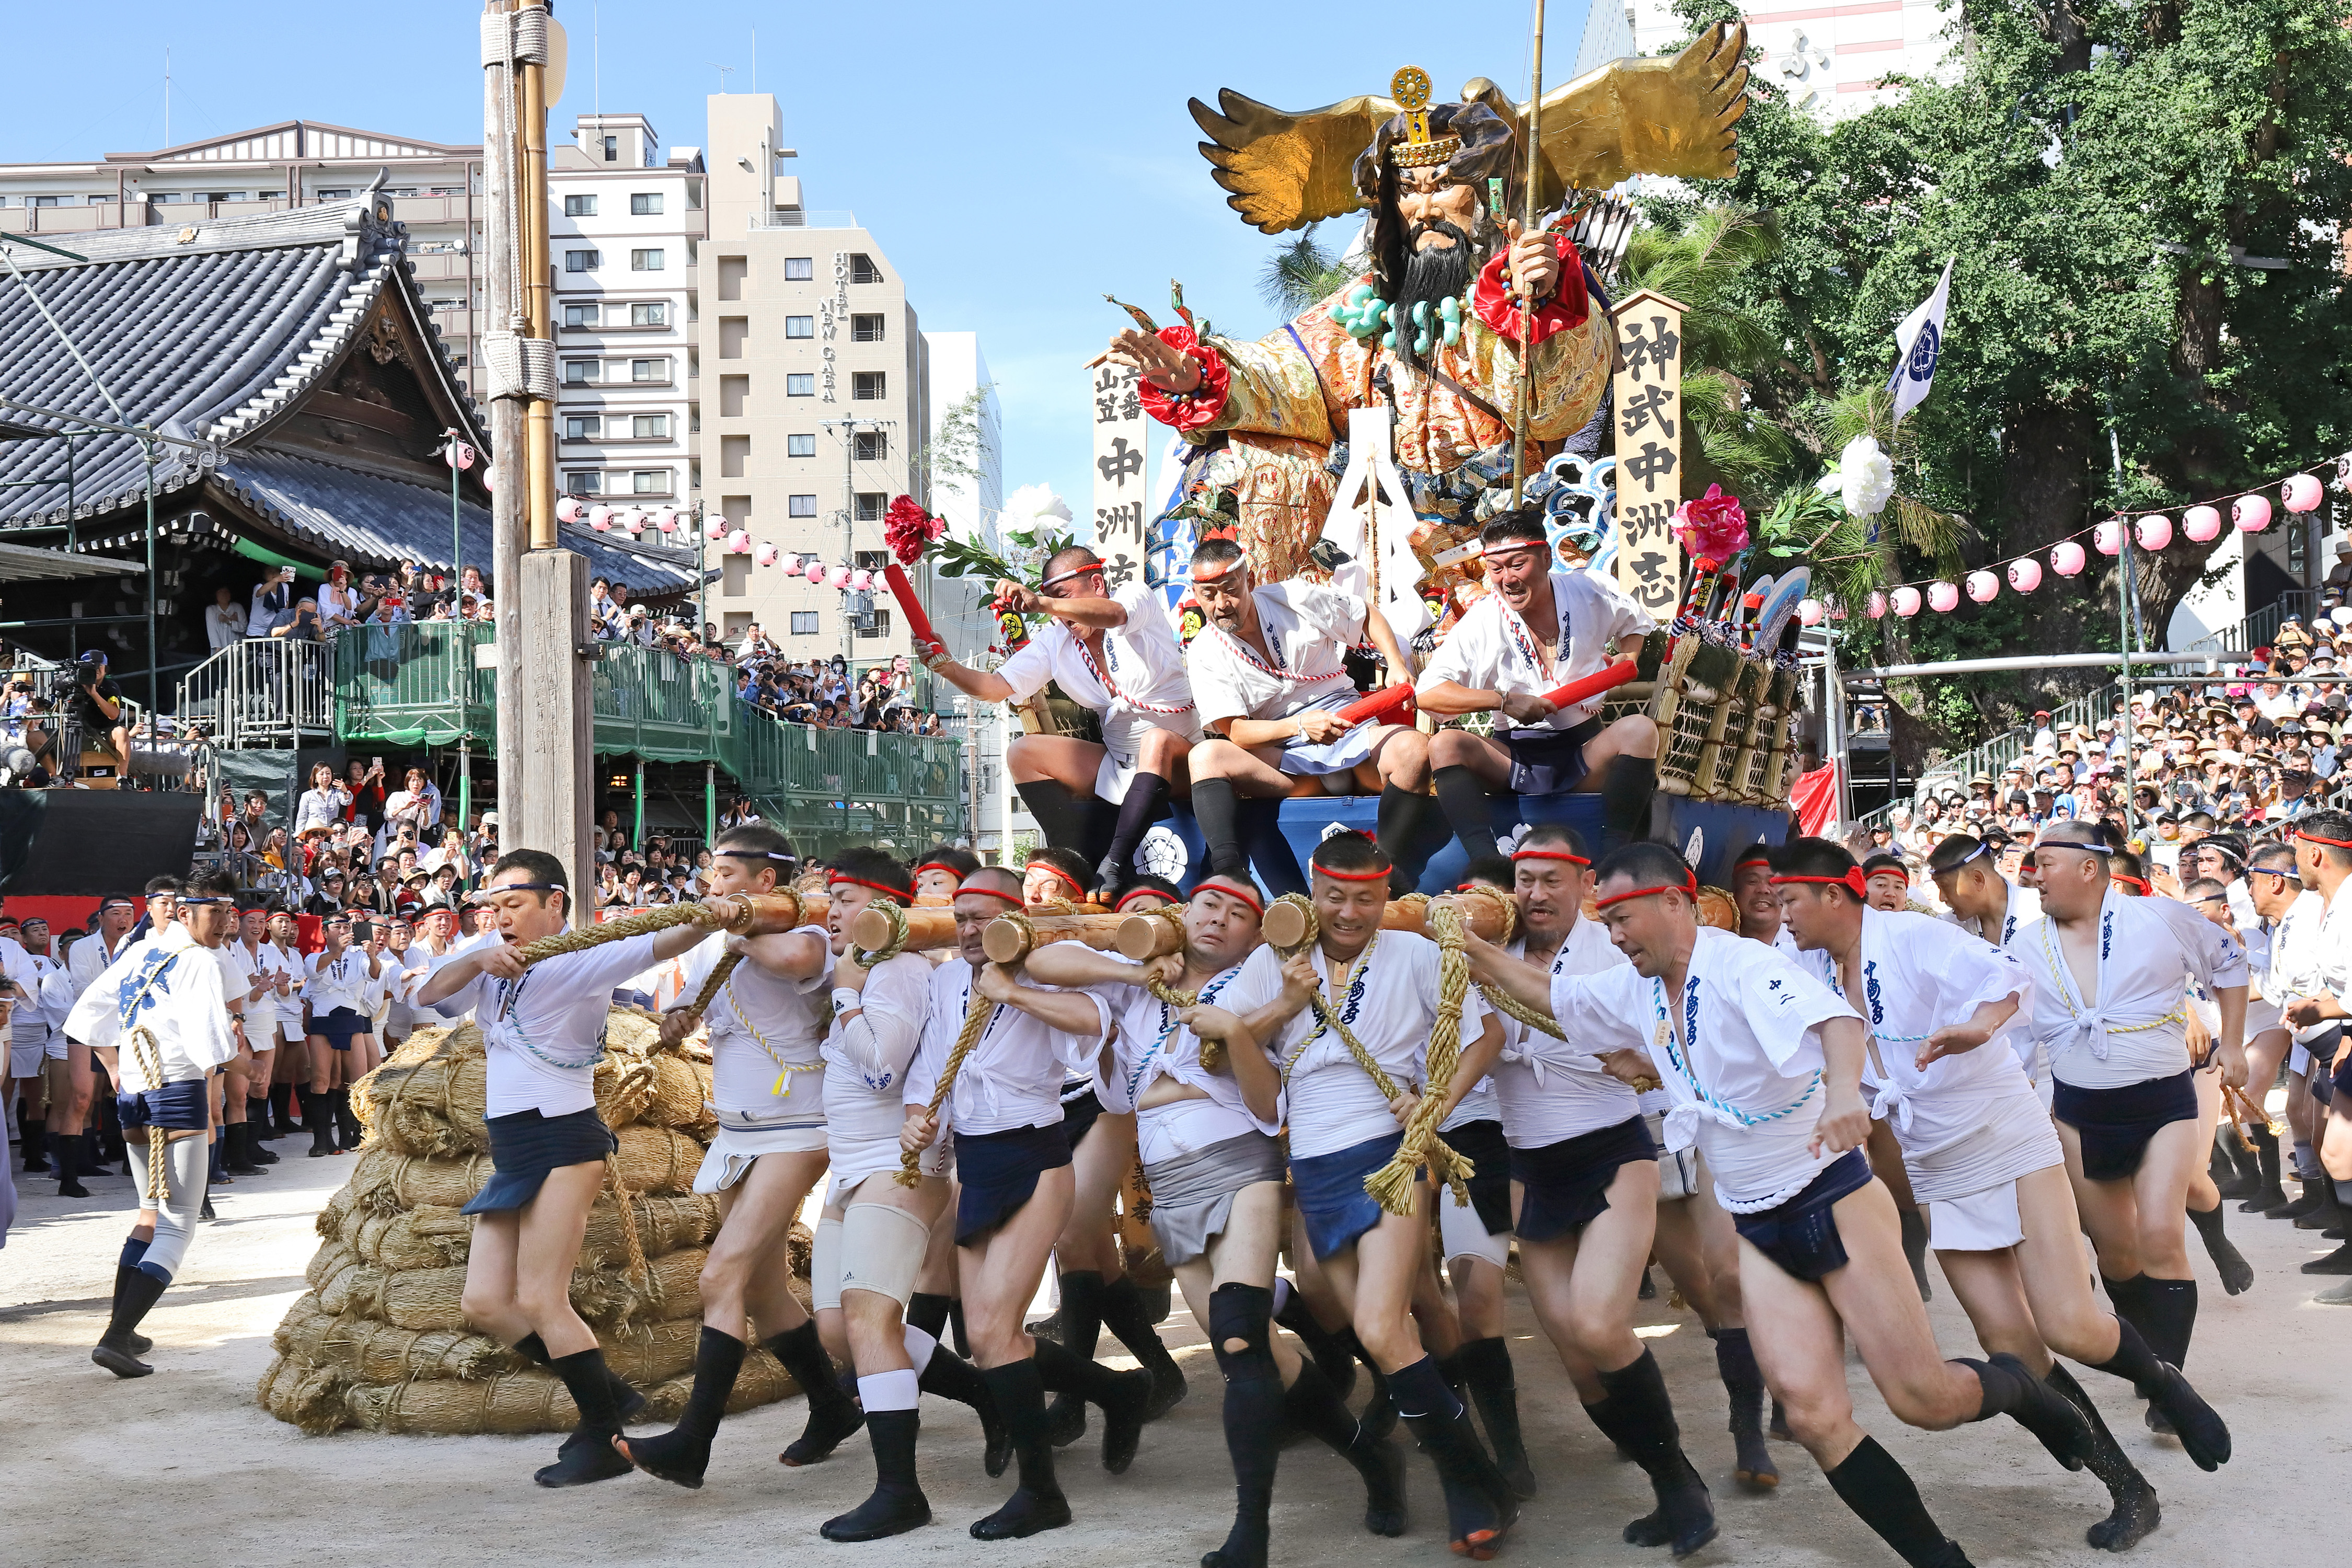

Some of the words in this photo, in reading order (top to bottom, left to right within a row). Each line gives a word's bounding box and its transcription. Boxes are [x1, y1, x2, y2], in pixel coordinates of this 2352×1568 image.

[833, 252, 847, 319] HOTEL
[819, 298, 836, 338] NEW
[820, 346, 835, 400] GAEA
[1096, 368, 1118, 424] 山笠
[1121, 366, 1142, 421] 六番
[1619, 316, 1680, 608] 神武中洲志
